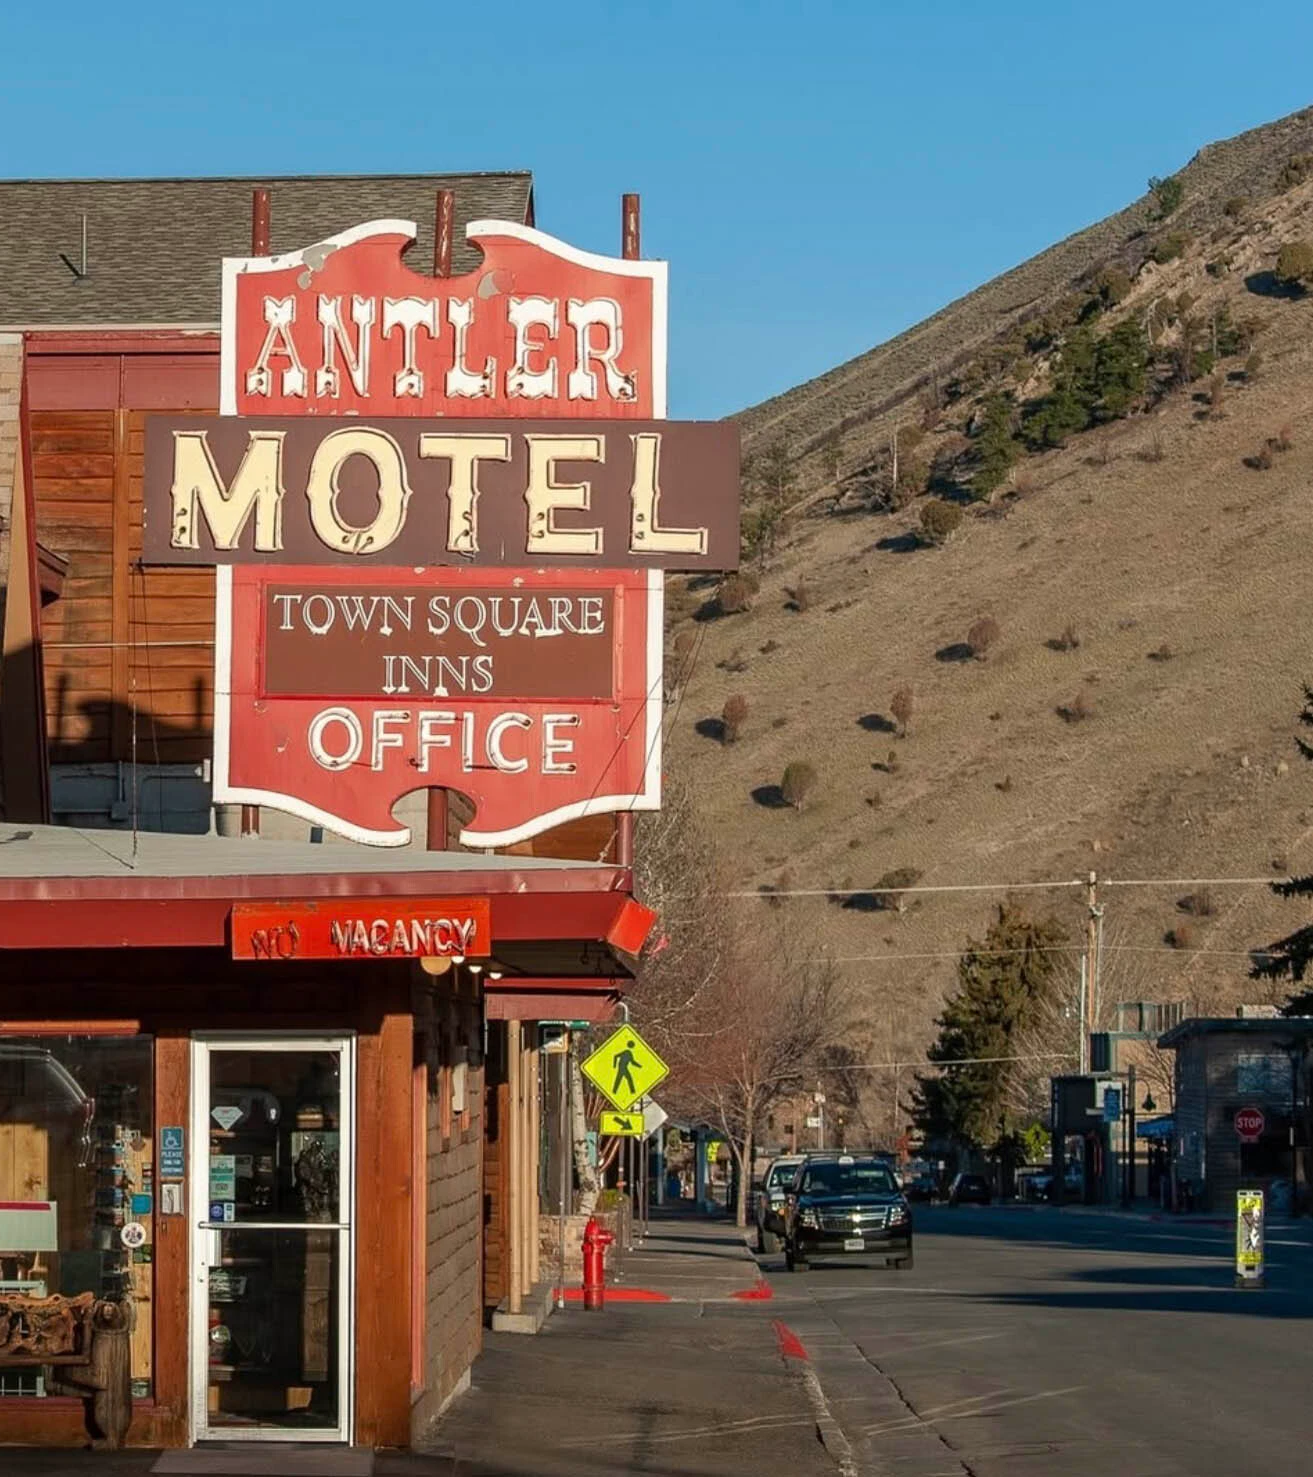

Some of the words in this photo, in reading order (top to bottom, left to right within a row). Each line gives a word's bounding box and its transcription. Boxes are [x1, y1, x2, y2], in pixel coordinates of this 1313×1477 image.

[245, 294, 639, 401] ANTLER
[170, 426, 709, 556] MOTEL
[273, 592, 414, 637] TOWN
[427, 595, 606, 648] SQUARE
[381, 654, 495, 697] INNS
[306, 706, 581, 774] OFFICE
[250, 920, 301, 959] NO
[331, 918, 476, 956] VACANCY
[1238, 1117, 1262, 1128] STOP
